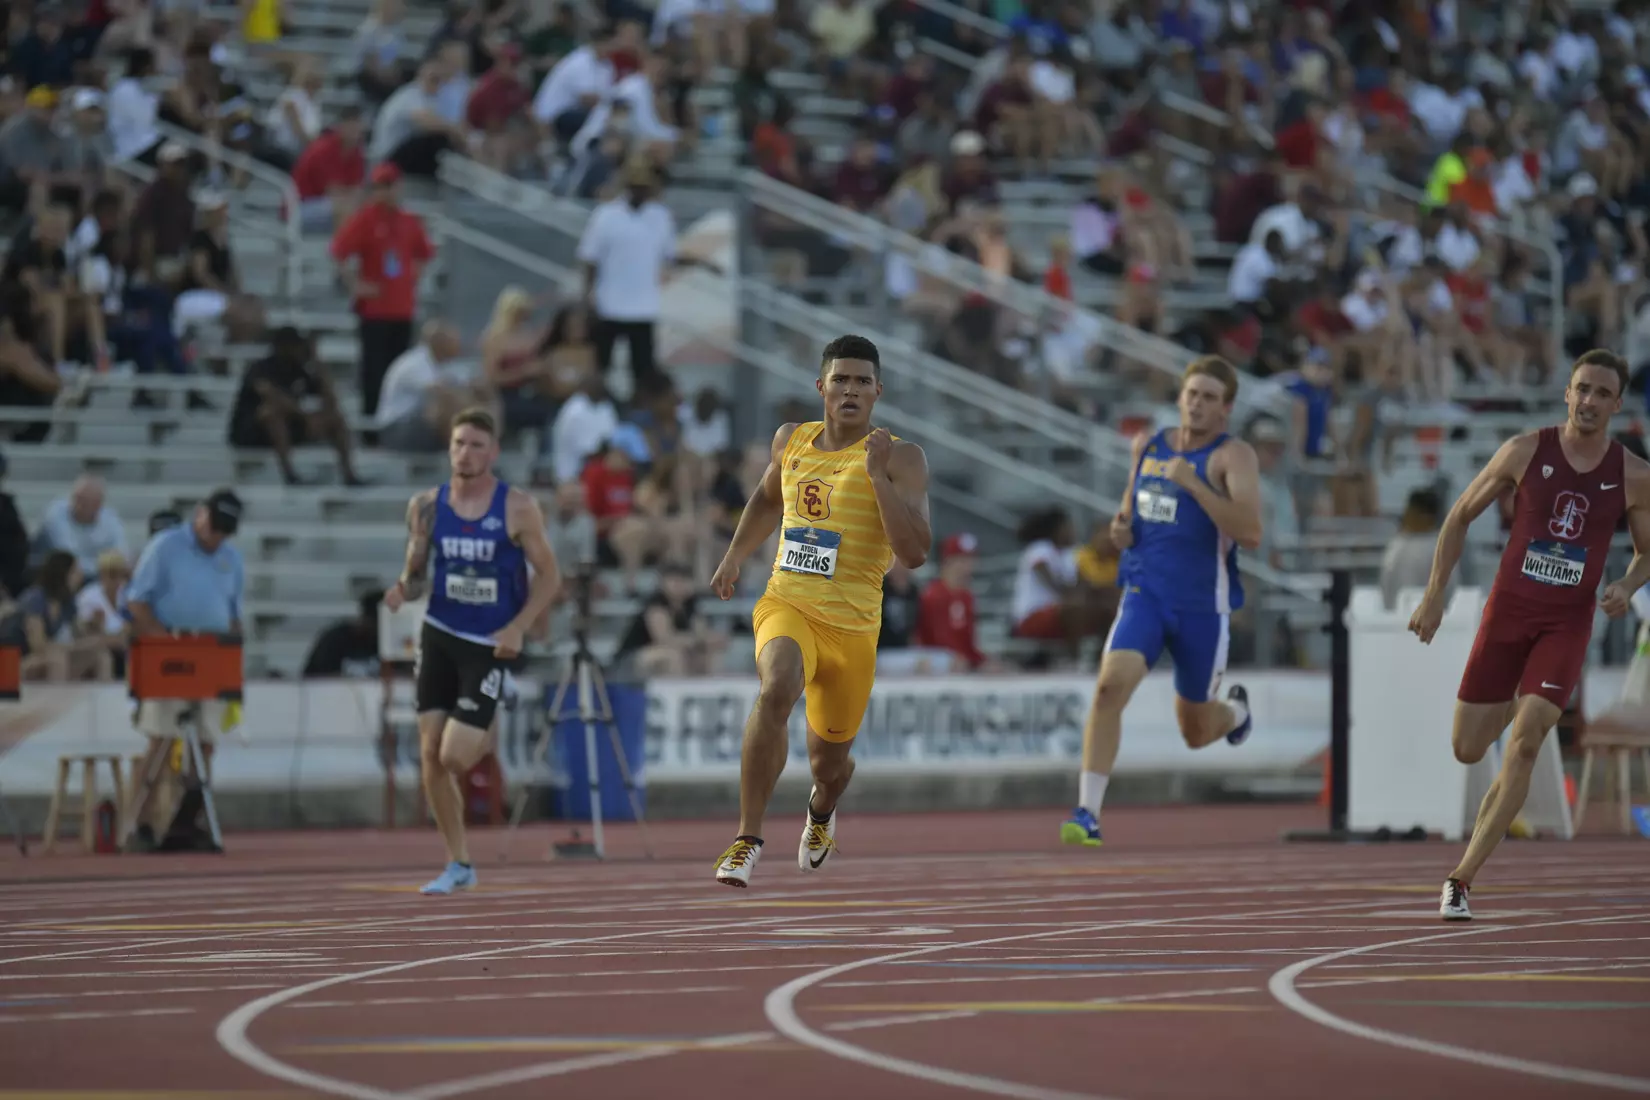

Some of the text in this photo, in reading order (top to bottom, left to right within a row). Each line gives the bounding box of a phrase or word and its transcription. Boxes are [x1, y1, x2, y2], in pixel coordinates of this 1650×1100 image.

[800, 545, 819, 554] AYDEN
[786, 550, 830, 571] OWENS
[1524, 556, 1581, 584] WILLIAMS
